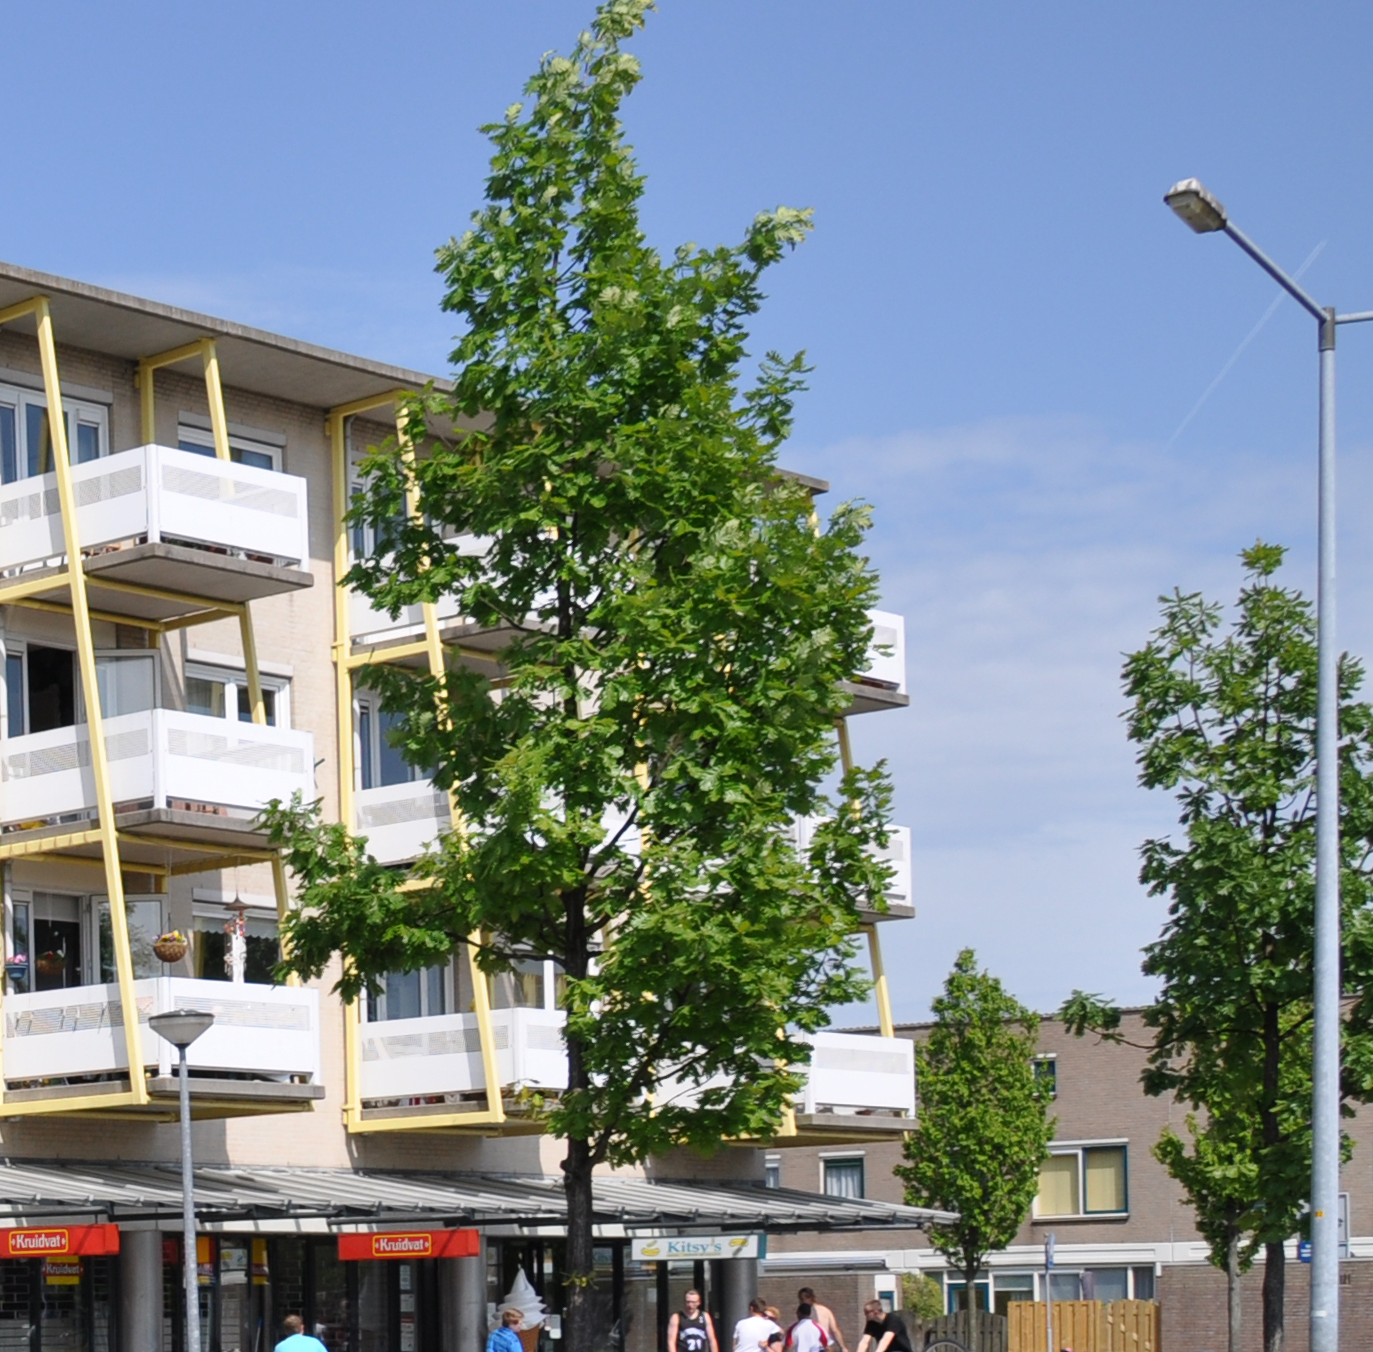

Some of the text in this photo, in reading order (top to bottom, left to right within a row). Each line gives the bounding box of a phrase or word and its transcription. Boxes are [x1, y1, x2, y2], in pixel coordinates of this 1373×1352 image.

[16, 1234, 61, 1249] Kruidvat
[380, 1237, 424, 1251] Kruidvat
[667, 1240, 722, 1253] Kitsy's
[46, 1263, 80, 1275] Kruidvat
